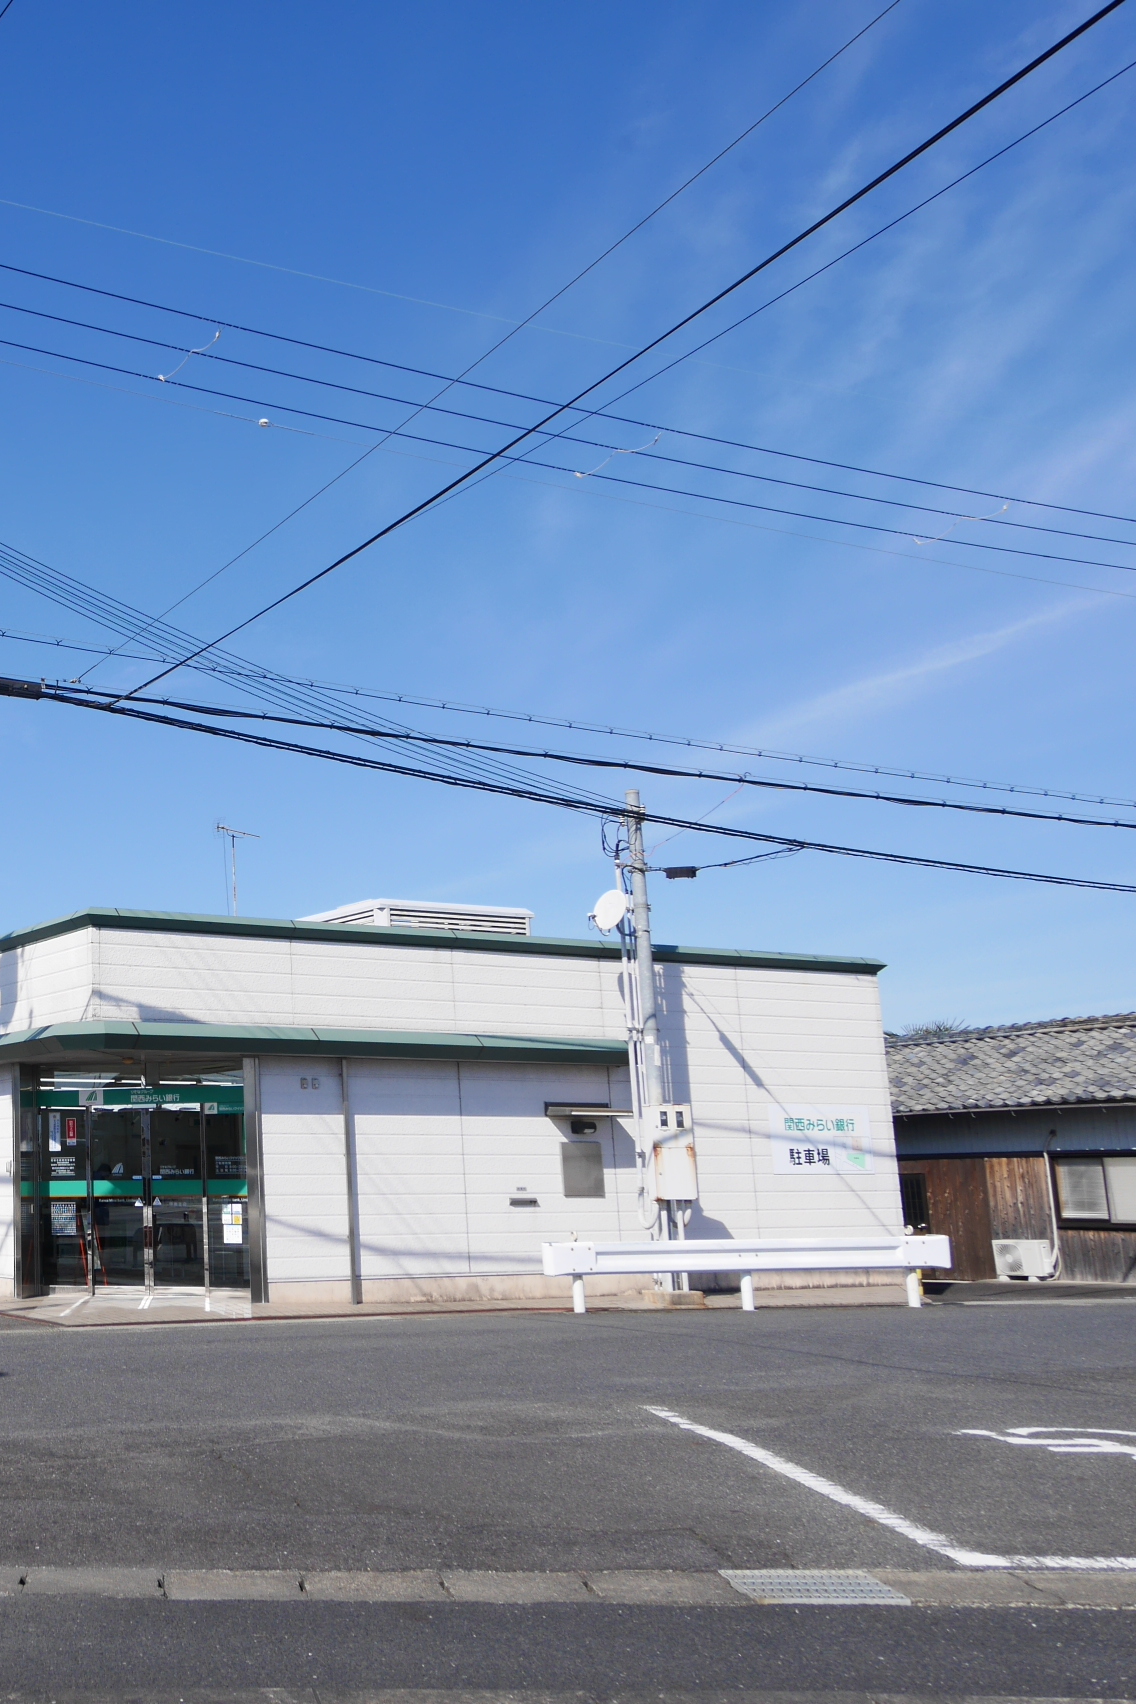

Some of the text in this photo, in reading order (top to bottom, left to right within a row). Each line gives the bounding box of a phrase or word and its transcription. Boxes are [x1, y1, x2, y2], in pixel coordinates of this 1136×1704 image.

[130, 1093, 180, 1103] 関西みらい銀行
[784, 1117, 855, 1132] 関西みらい銀行
[789, 1148, 831, 1166] 駐車場
